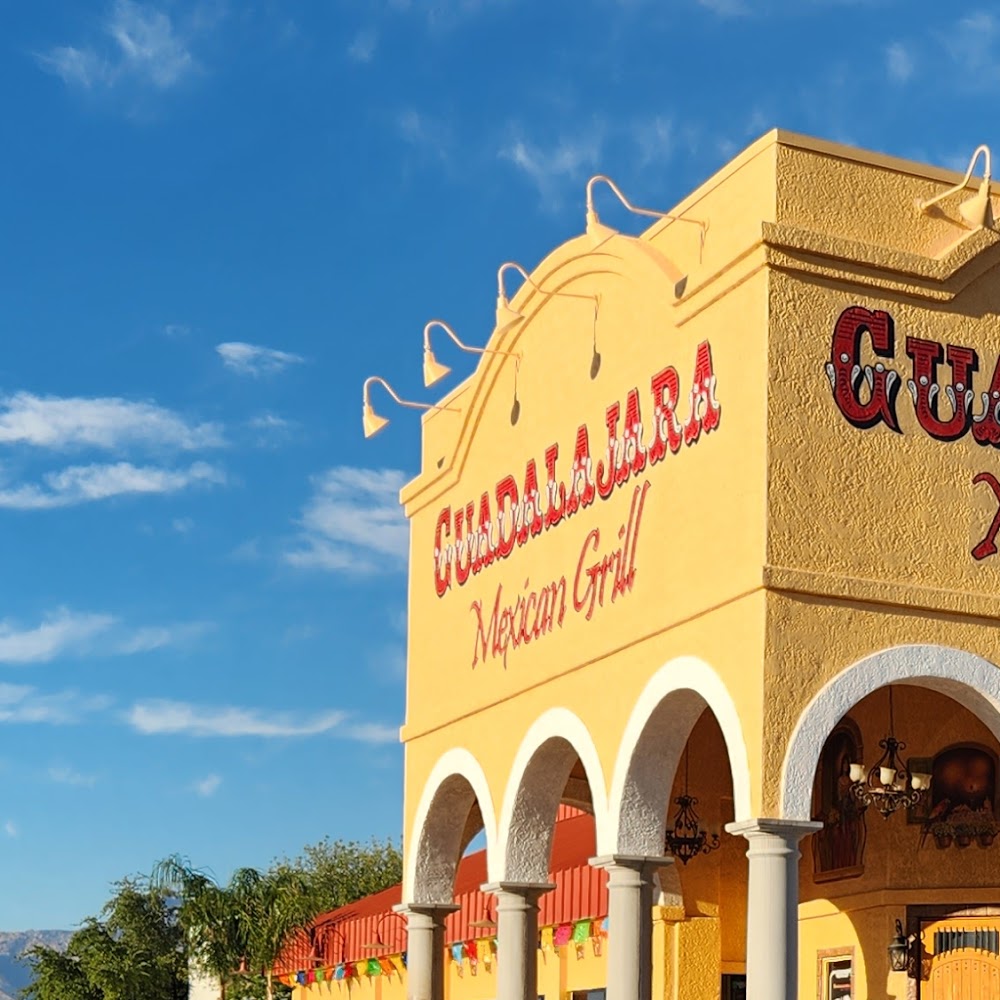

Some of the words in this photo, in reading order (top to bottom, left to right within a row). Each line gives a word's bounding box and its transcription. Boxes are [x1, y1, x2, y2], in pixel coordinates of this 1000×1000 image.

[434, 339, 721, 597] GUADALAJARA
[470, 577, 567, 670] Mexican
[573, 480, 650, 621] Grill
